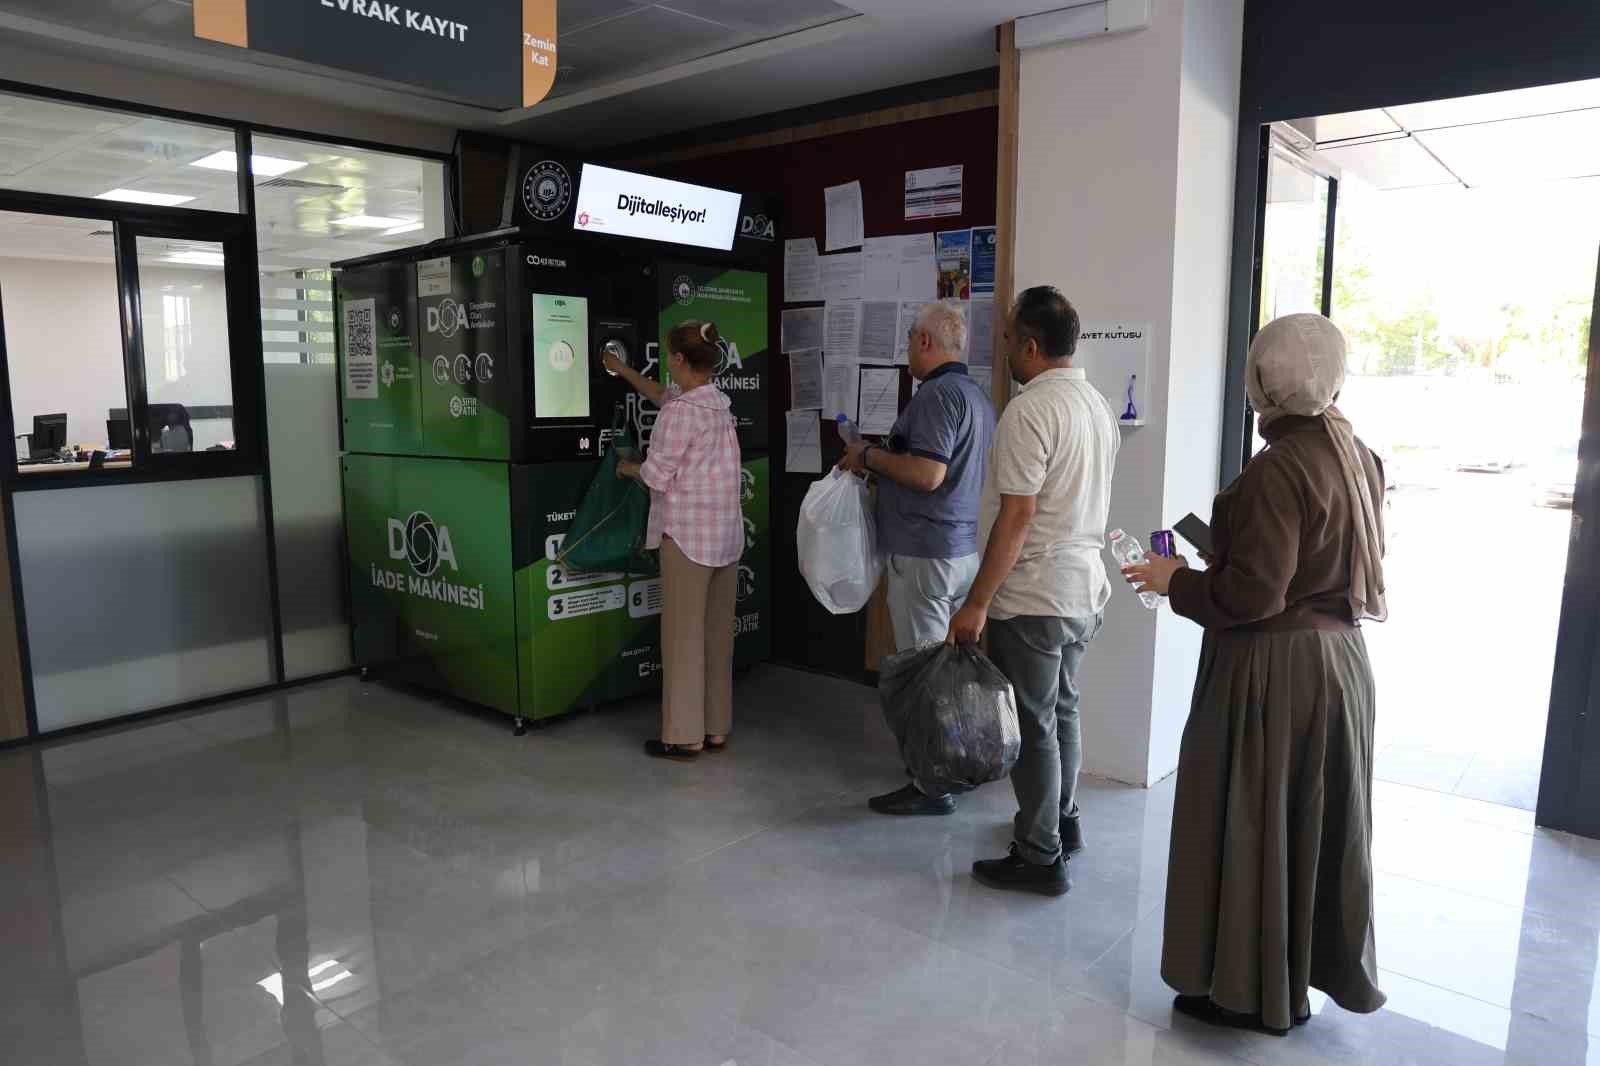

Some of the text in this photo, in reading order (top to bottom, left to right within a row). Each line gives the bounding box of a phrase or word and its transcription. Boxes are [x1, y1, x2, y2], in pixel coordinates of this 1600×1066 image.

[405, 9, 469, 42] KAYIT
[523, 33, 556, 52] Zemin
[531, 51, 549, 66] Kat
[617, 194, 706, 224] Dijitalleşiyor!
[1080, 331, 1142, 340] AYET KUTUSU
[713, 374, 760, 390] AKİNESİ
[546, 509, 577, 522] TÜKET
[388, 511, 458, 577] DOA
[551, 569, 562, 585] 2
[371, 562, 485, 610] İADE MAKİNESİ
[552, 599, 564, 615] 3
[632, 592, 642, 606] 6
